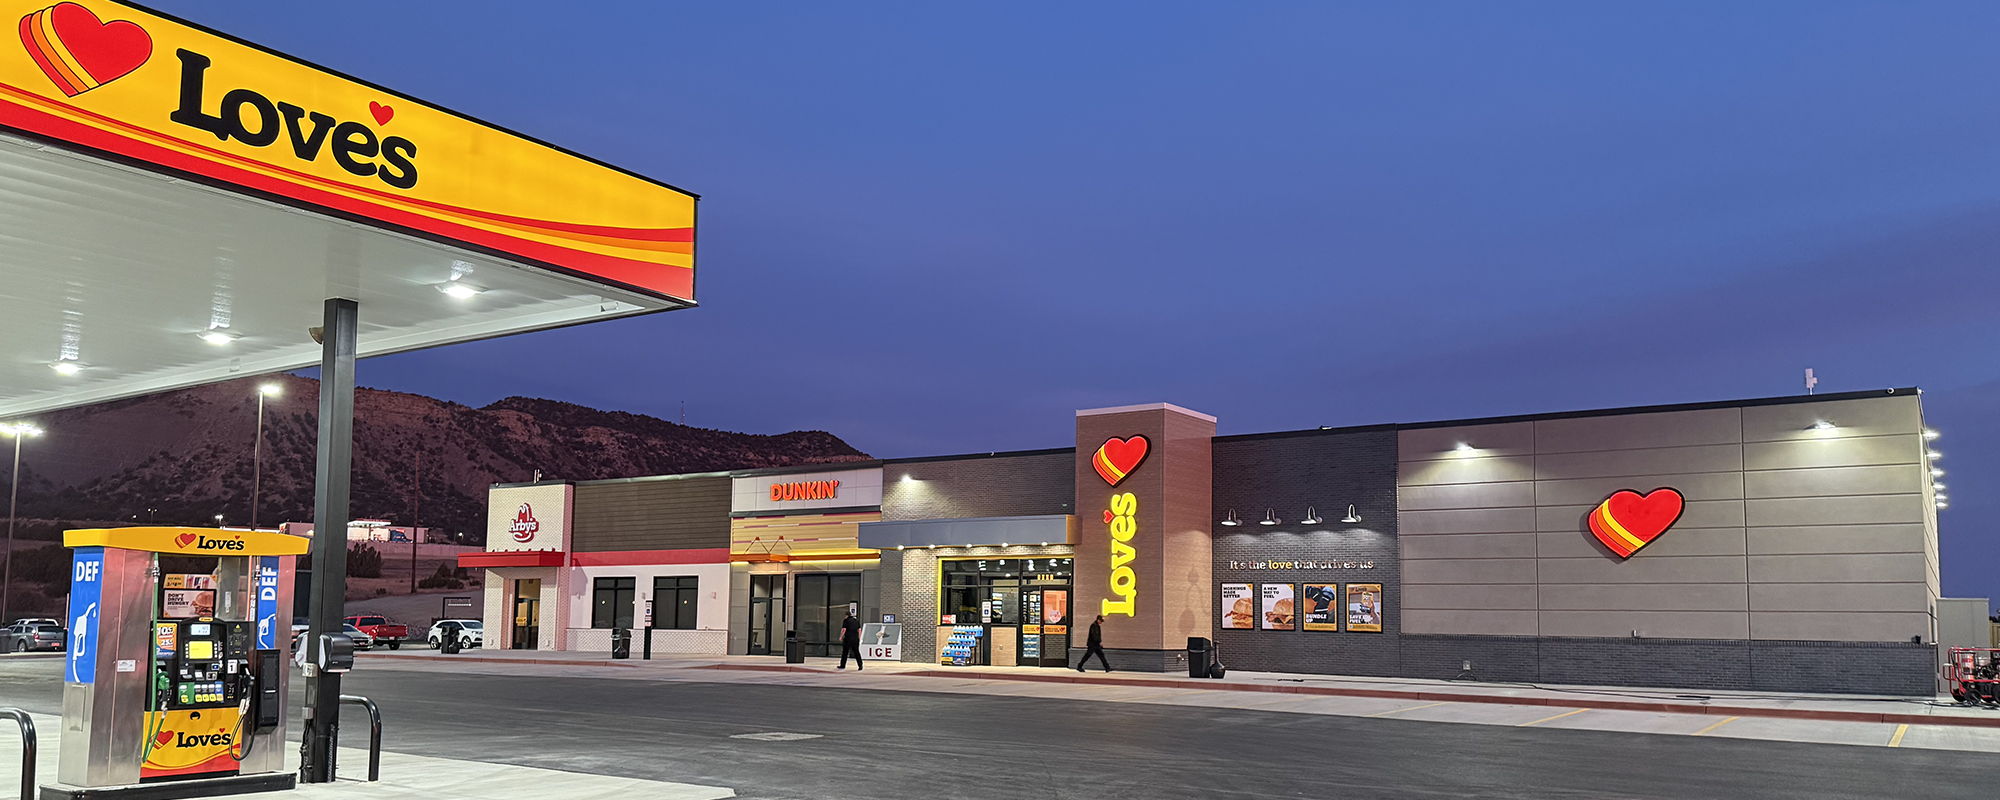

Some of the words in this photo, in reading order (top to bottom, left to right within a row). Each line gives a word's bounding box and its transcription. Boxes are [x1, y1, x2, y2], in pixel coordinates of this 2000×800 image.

[770, 479, 840, 501] DUNKIN'
[509, 518, 537, 534] Arby's
[75, 561, 99, 582] DEF
[1249, 560, 1266, 570] the
[1268, 559, 1293, 570] love
[1294, 560, 1318, 570] that
[1320, 559, 1356, 569] drives
[1359, 560, 1374, 569] us
[260, 566, 278, 601] DEF
[869, 647, 893, 658] ICE
